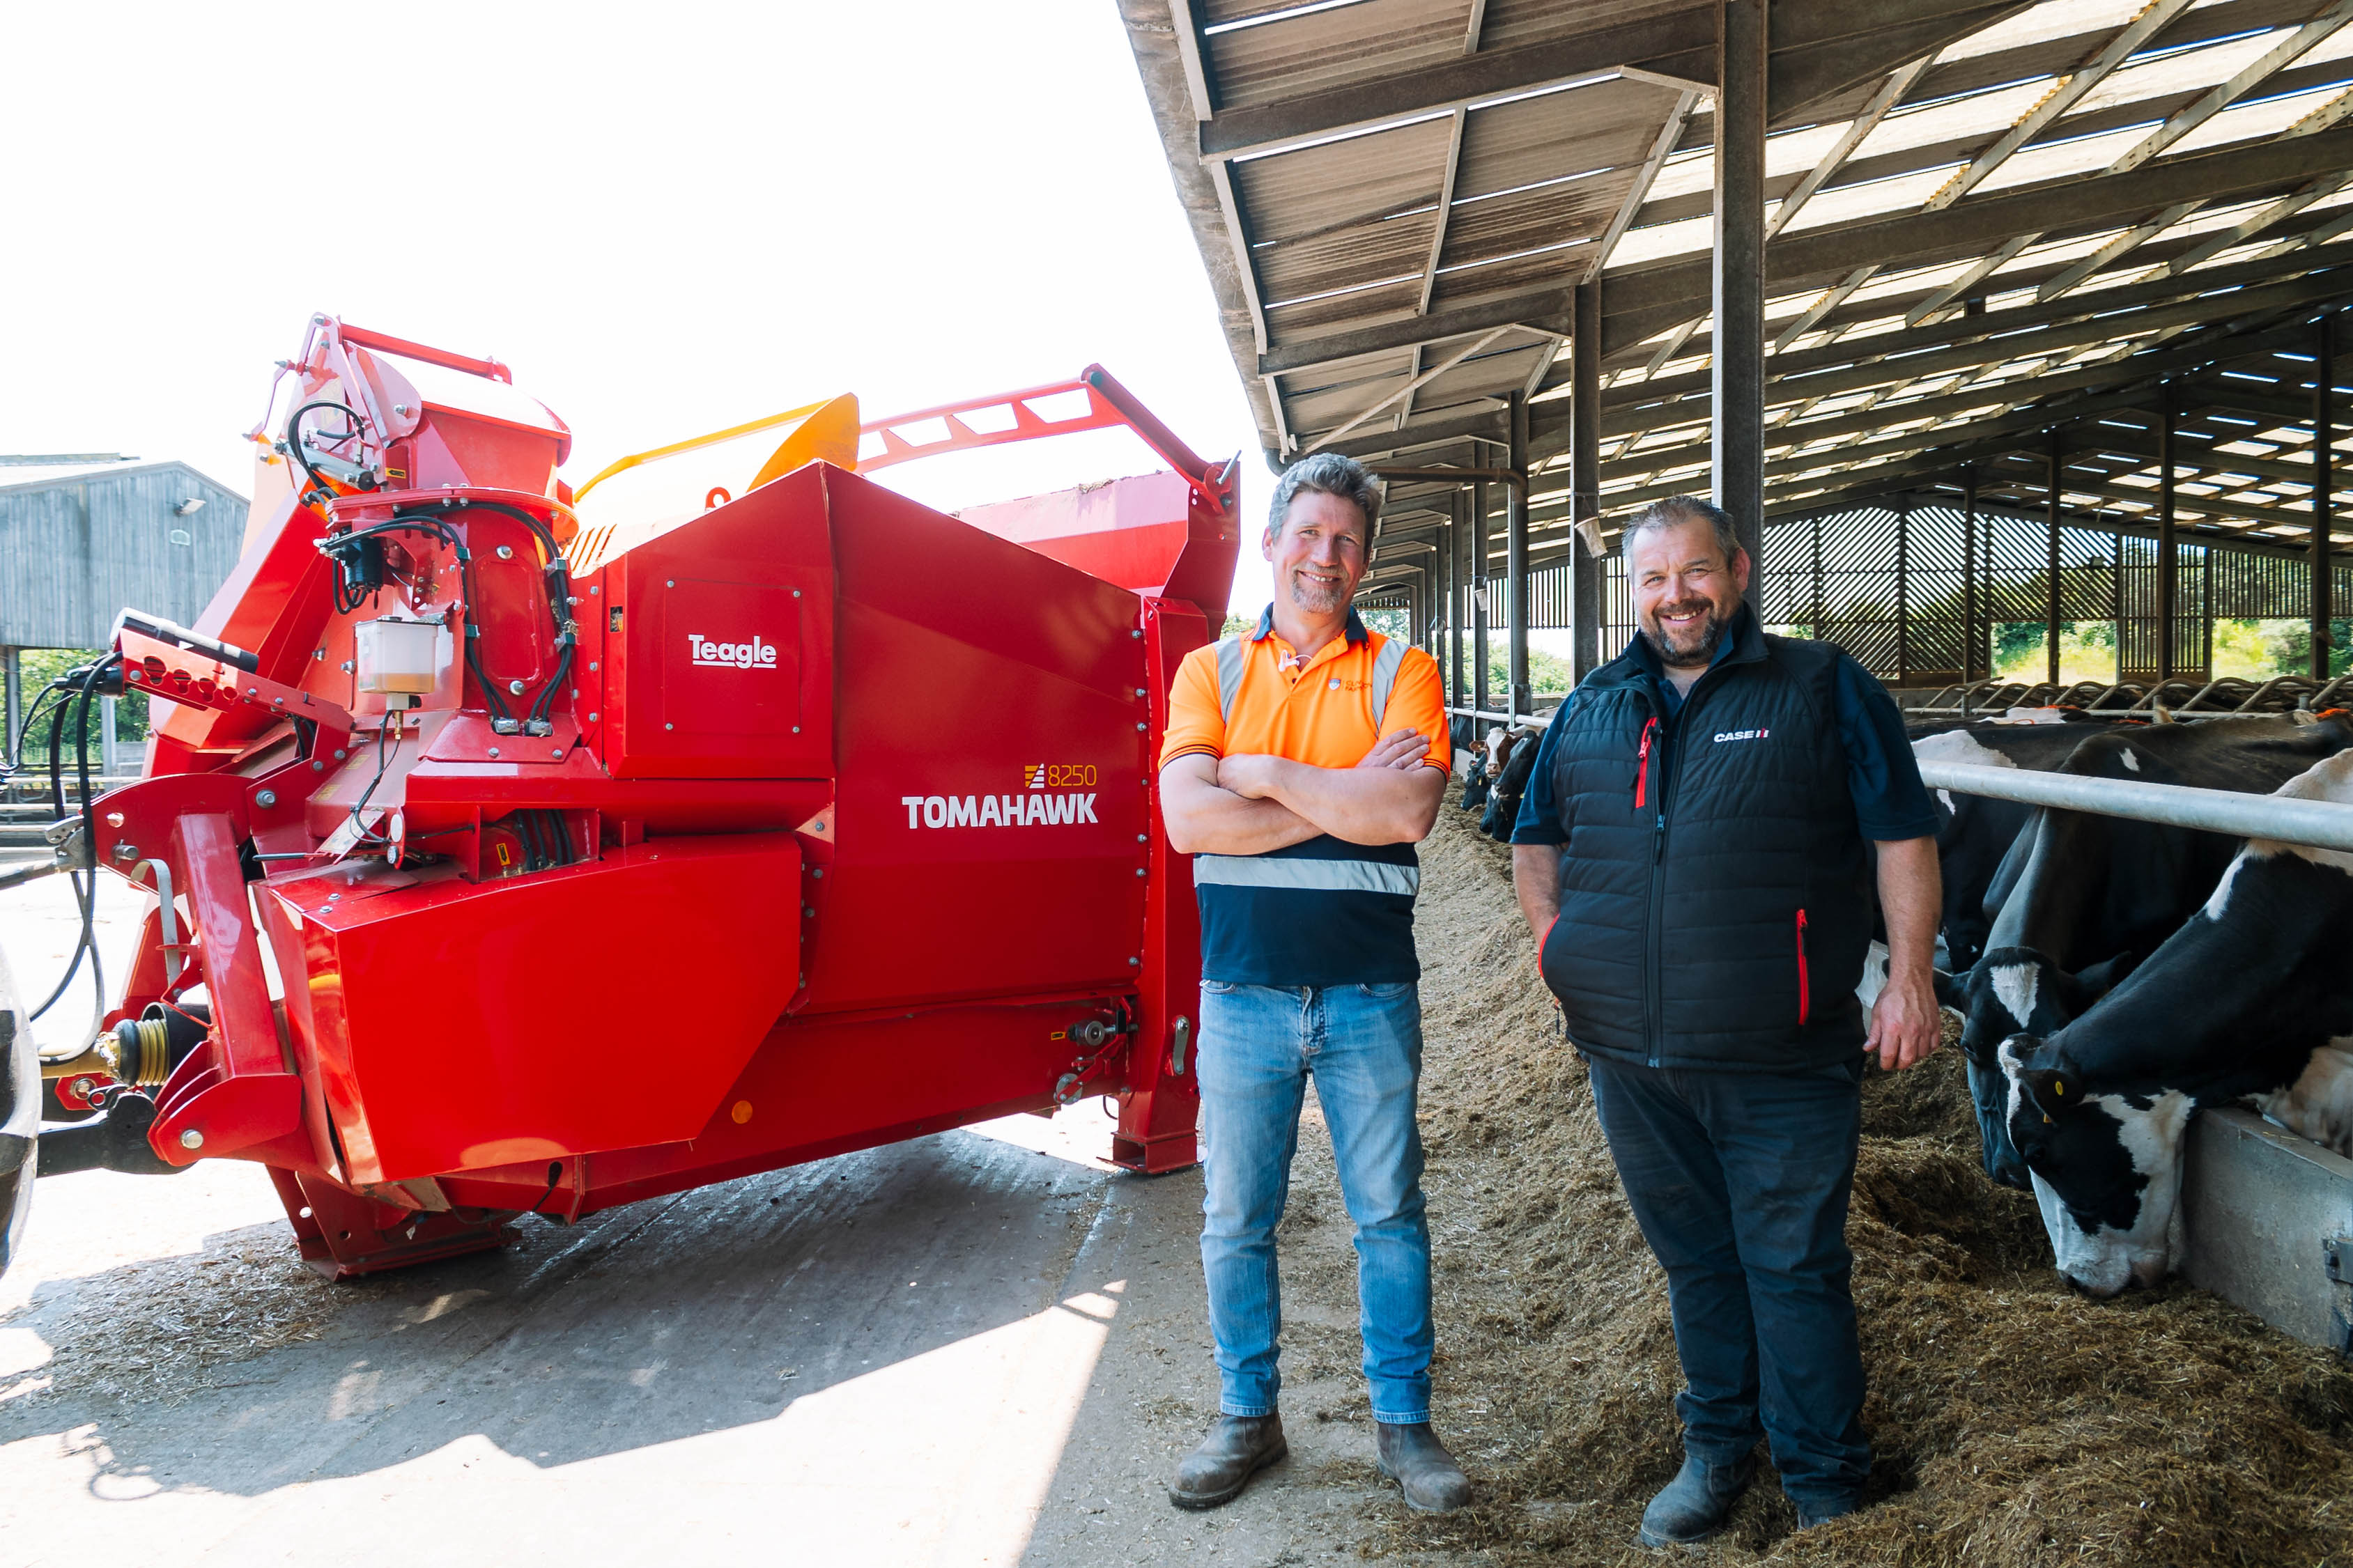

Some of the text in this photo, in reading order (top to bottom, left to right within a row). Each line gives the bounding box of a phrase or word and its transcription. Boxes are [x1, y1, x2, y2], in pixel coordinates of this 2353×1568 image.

[688, 635, 776, 669] Teagle
[1714, 730, 1754, 743] CASE
[1048, 765, 1097, 786] 8250
[902, 793, 1098, 829] TOMAHAWK
